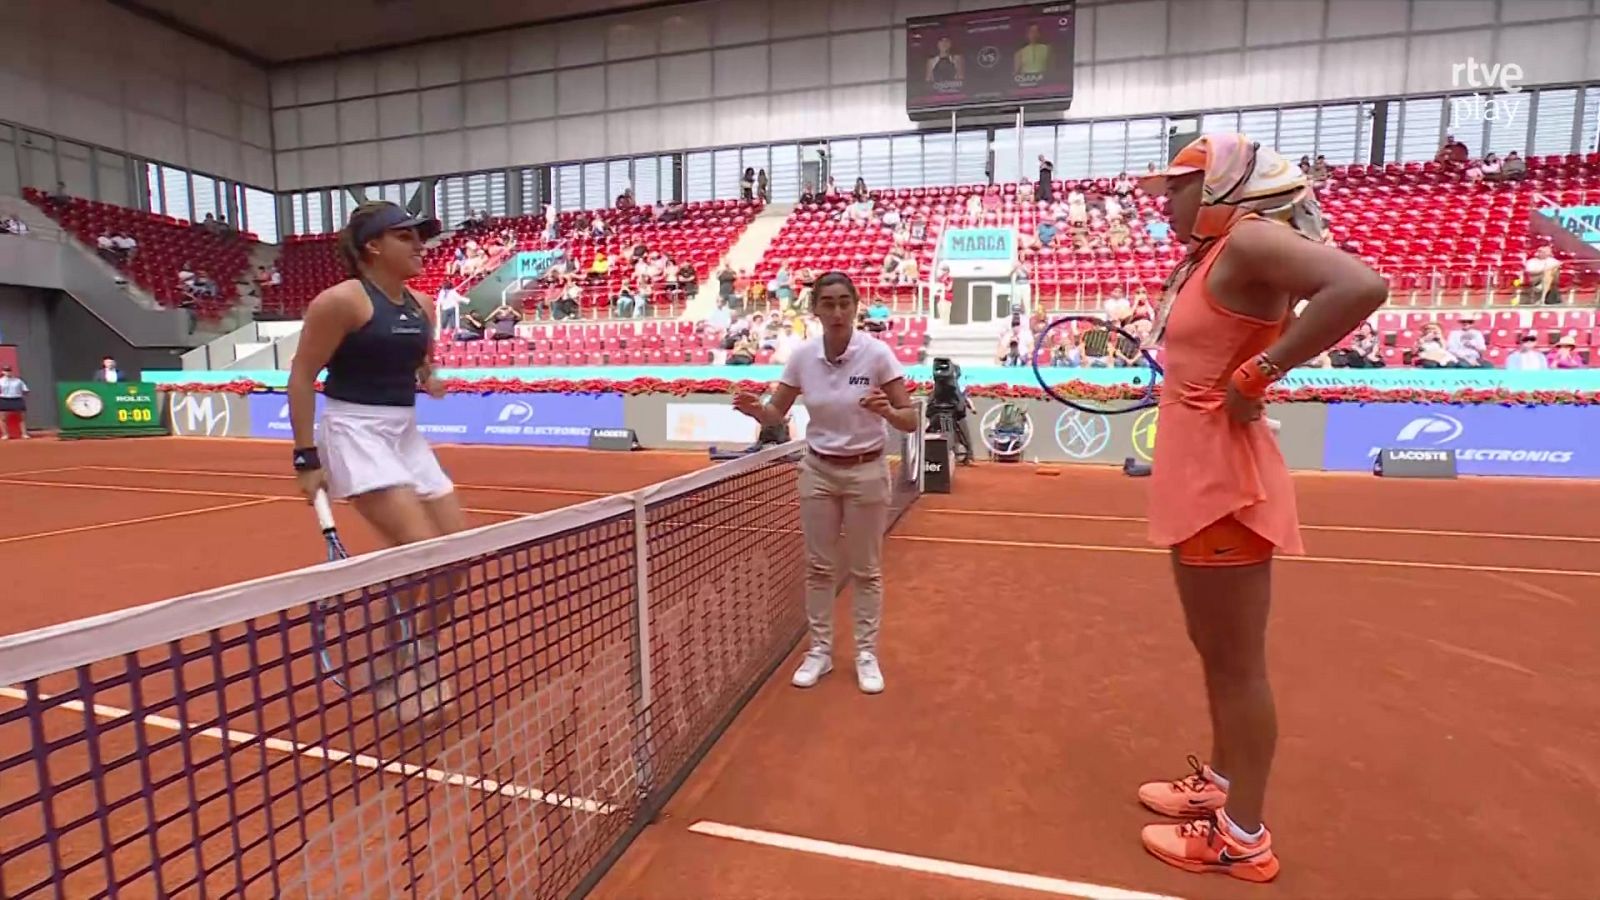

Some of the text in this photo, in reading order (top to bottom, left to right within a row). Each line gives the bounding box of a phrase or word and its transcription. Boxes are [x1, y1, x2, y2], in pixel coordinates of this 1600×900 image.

[952, 236, 1005, 251] MARCA
[119, 409, 151, 421] 0:00
[523, 427, 590, 436] ELECTRONIC
[594, 430, 628, 438] LACOSTE
[1389, 451, 1448, 461] LACOSTE
[1455, 449, 1574, 463] LECTRONICS
